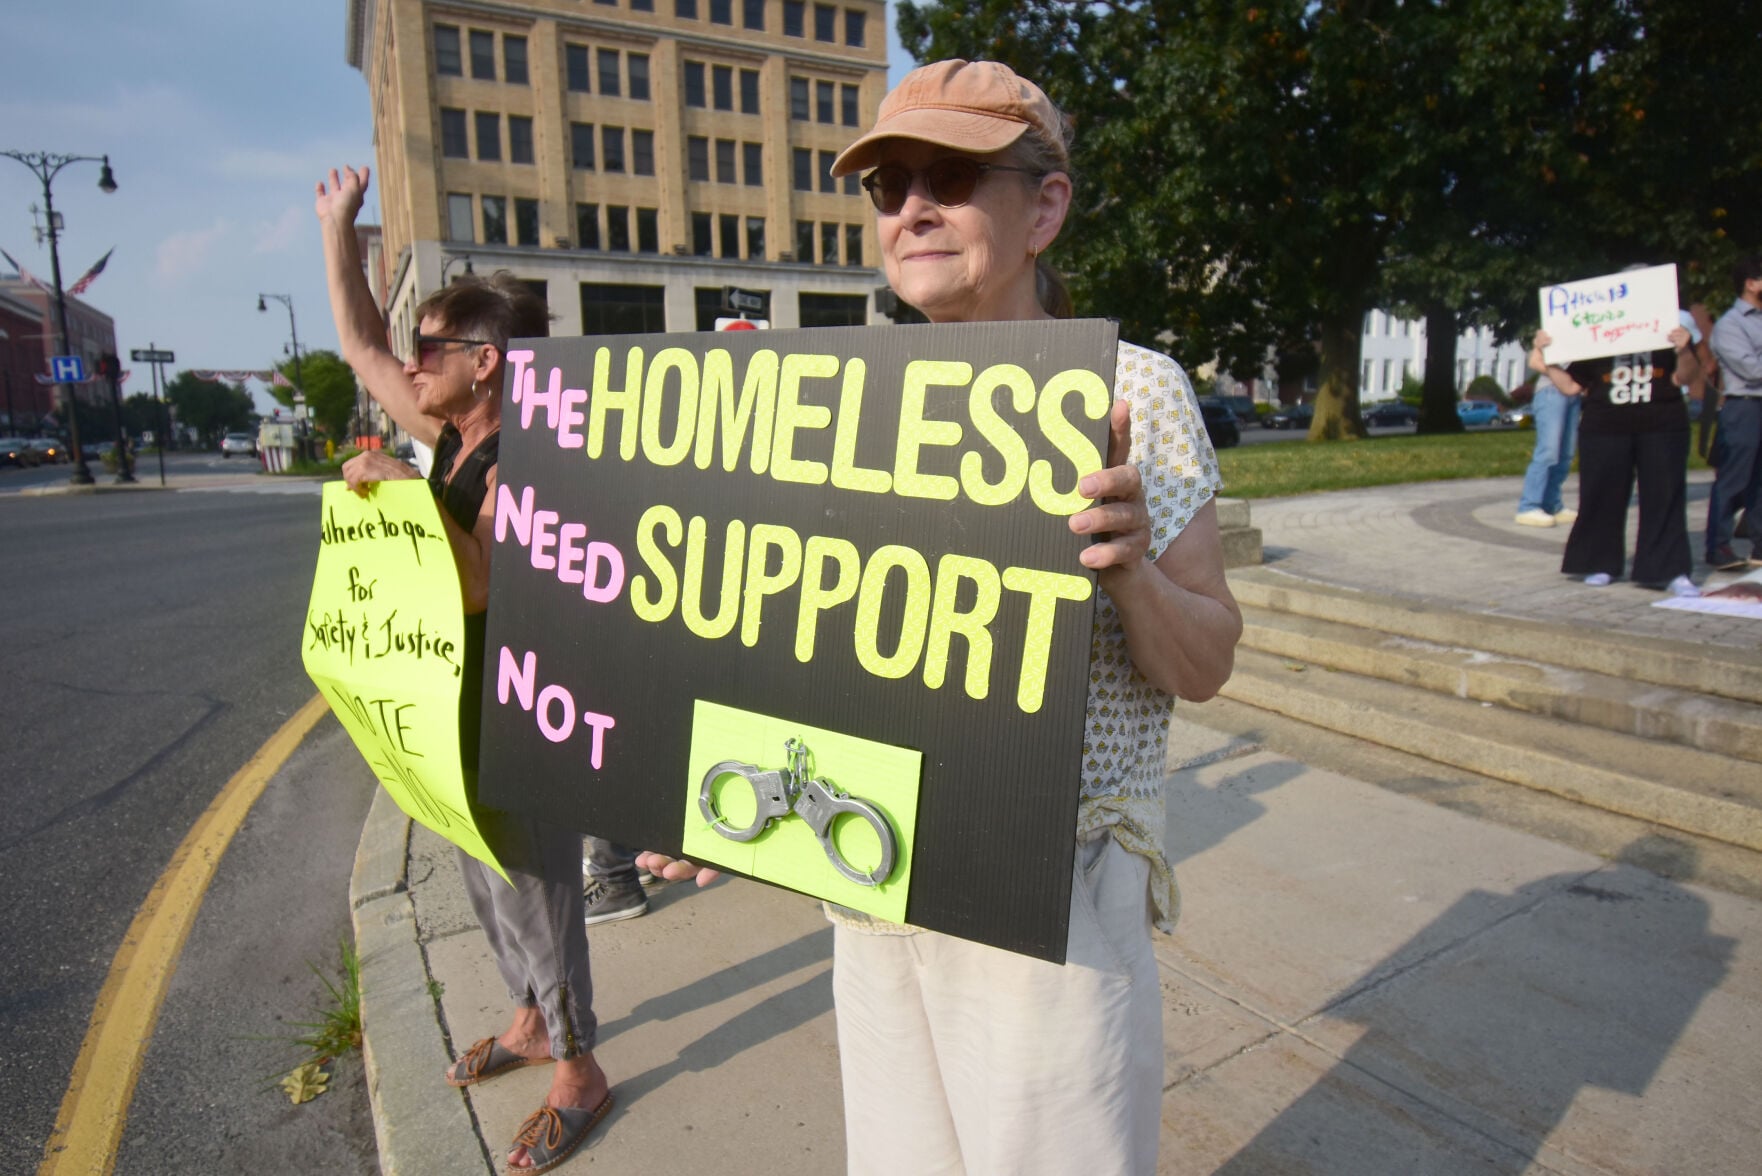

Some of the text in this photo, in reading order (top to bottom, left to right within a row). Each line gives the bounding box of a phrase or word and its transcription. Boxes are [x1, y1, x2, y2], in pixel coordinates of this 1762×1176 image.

[57, 359, 78, 379] H
[506, 346, 1109, 516] THE HOMELESS
[378, 508, 399, 538] to
[347, 566, 377, 602] for
[494, 485, 1093, 714] NEED SUPPORT
[309, 609, 355, 667] Safety
[497, 646, 615, 770] NOT
